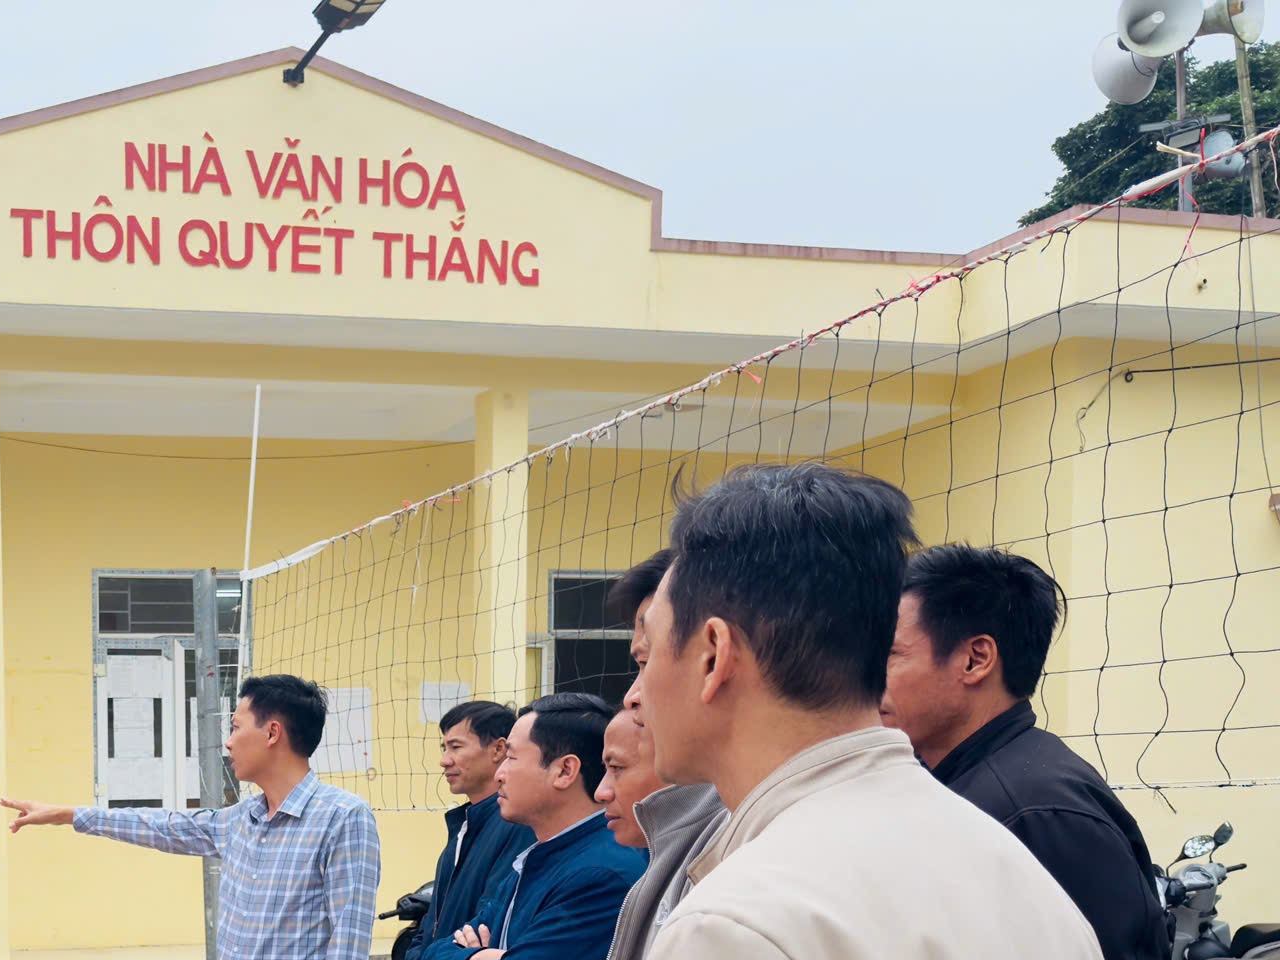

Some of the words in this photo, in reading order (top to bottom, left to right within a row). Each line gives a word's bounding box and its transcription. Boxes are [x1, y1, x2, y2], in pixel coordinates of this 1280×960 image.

[124, 131, 232, 196] NHÀ
[246, 137, 343, 204] VĂN
[359, 147, 466, 212] HÓA
[11, 196, 160, 265] THÔN
[178, 207, 355, 275] QUYẾT
[372, 214, 540, 287] THẮNG
